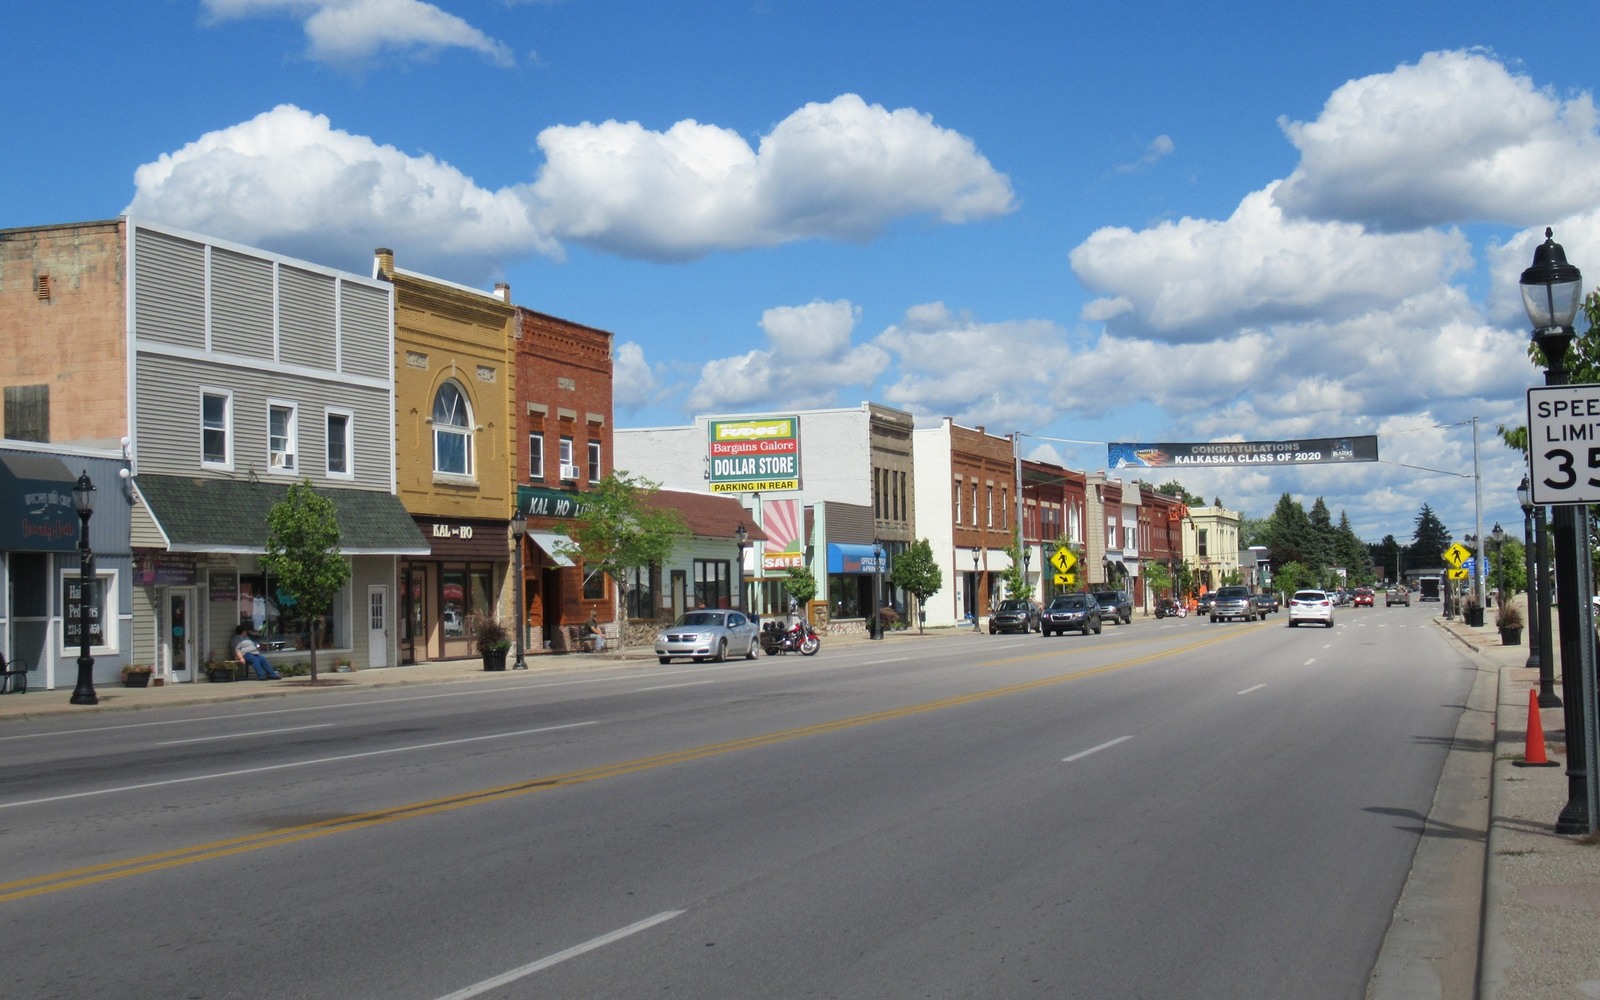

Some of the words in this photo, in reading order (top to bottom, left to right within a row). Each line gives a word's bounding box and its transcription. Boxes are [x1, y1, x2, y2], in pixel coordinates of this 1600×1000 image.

[1538, 399, 1600, 418] SPEE
[713, 442, 758, 455] Bargains
[760, 440, 794, 451] Galore
[1191, 442, 1300, 454] CONGRATULATIONS
[1174, 454, 1234, 464] KALKASKA
[1237, 453, 1275, 463] CLASS
[1276, 453, 1292, 462] OF
[1294, 451, 1321, 461] 2020
[714, 458, 756, 476] DOLLAR
[759, 456, 794, 474] STORE
[714, 483, 754, 492] PARKING
[757, 482, 766, 490] IN
[769, 481, 793, 489] REAR
[528, 497, 549, 515] KAL
[554, 499, 570, 516] HO
[764, 557, 801, 568] SALE
